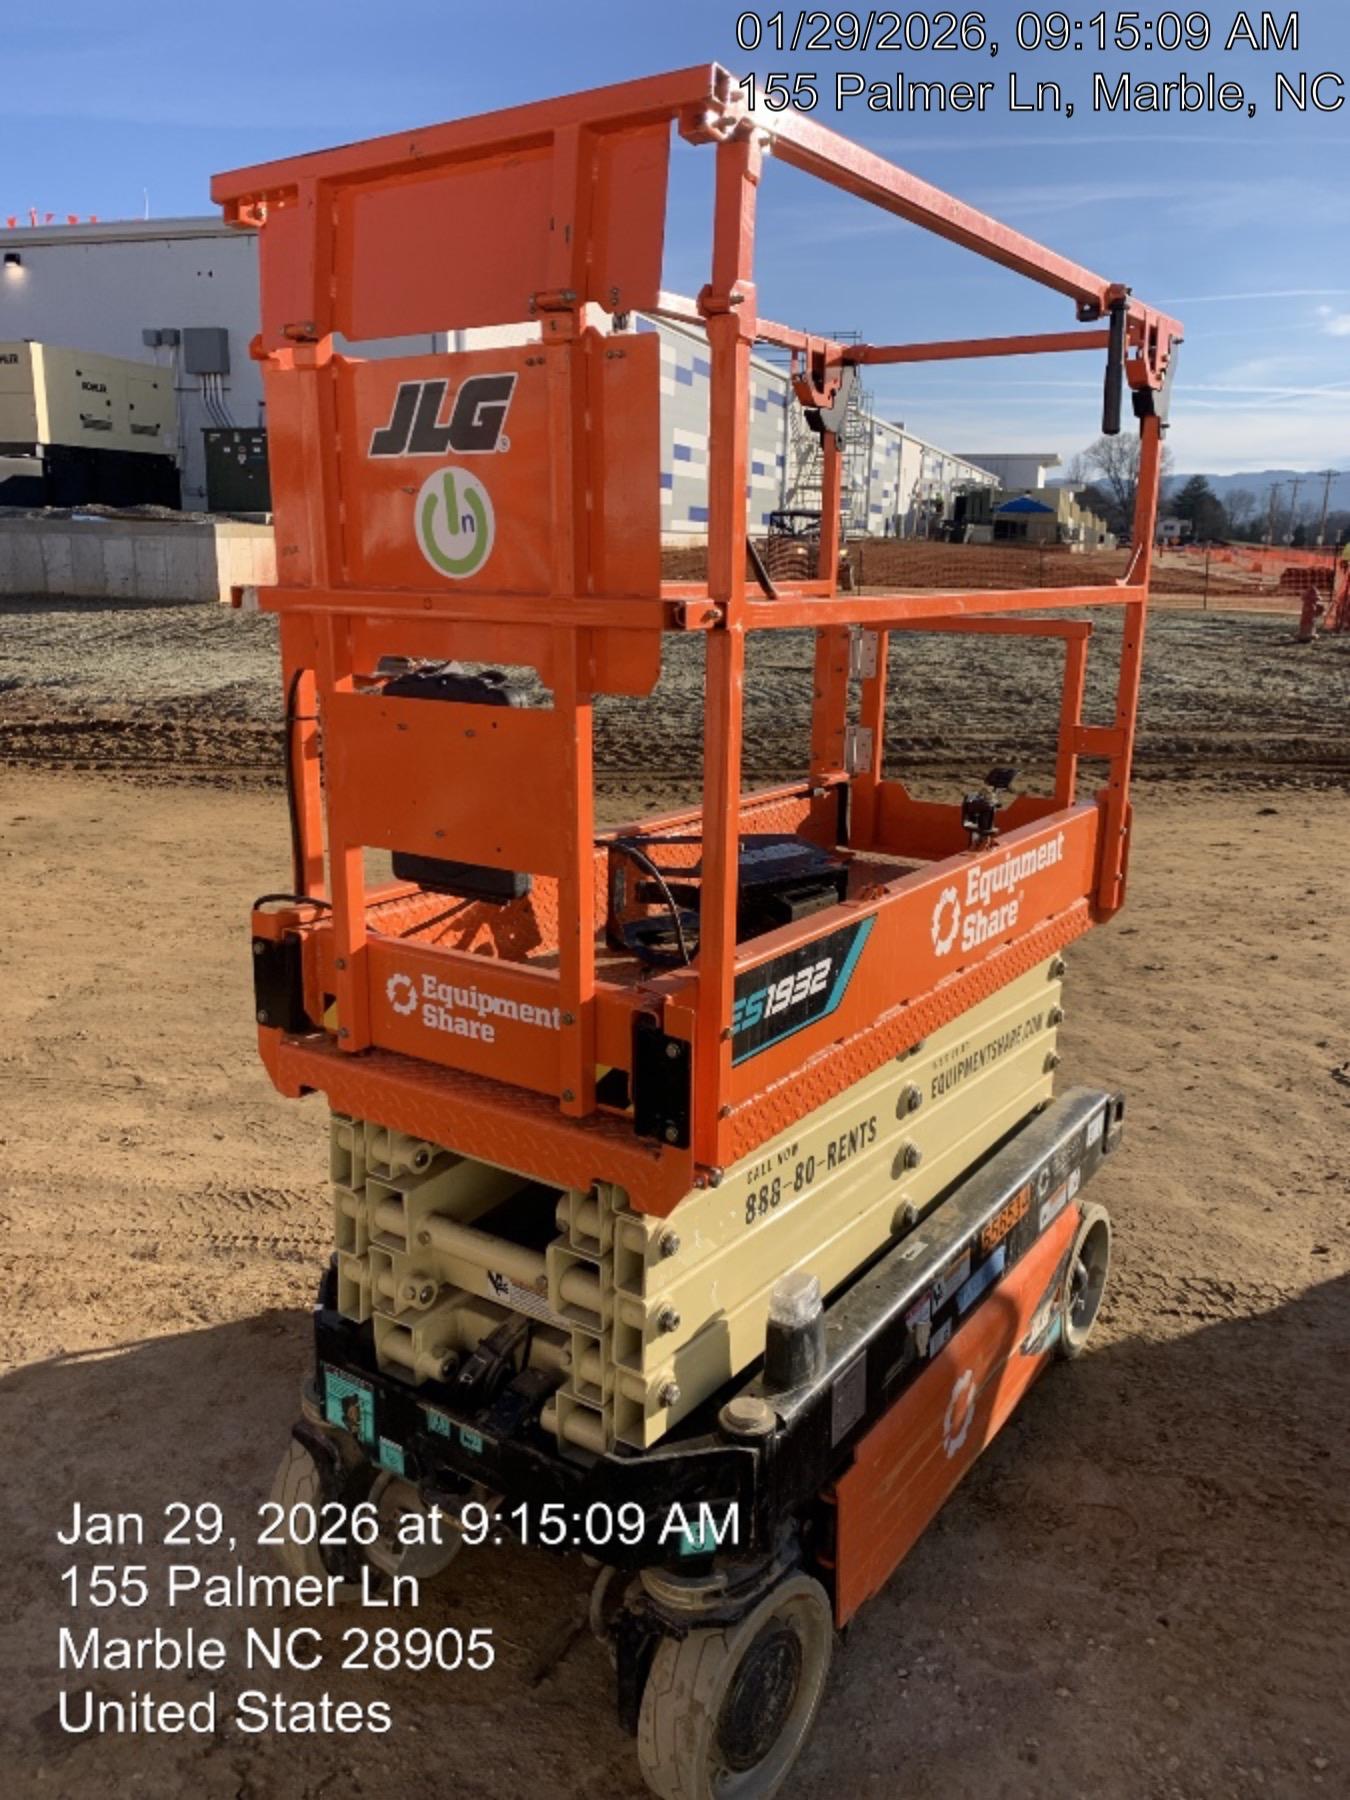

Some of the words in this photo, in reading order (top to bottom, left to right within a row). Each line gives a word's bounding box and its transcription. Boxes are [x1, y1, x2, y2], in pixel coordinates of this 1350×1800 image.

[368, 373, 518, 458] JLG
[965, 831, 1064, 907] Equipment
[961, 900, 1019, 953] Share
[422, 974, 561, 1031] Equipment
[422, 1003, 495, 1043] Share
[745, 1115, 877, 1225] 888-80-RENTS
[747, 1158, 773, 1185] CALL
